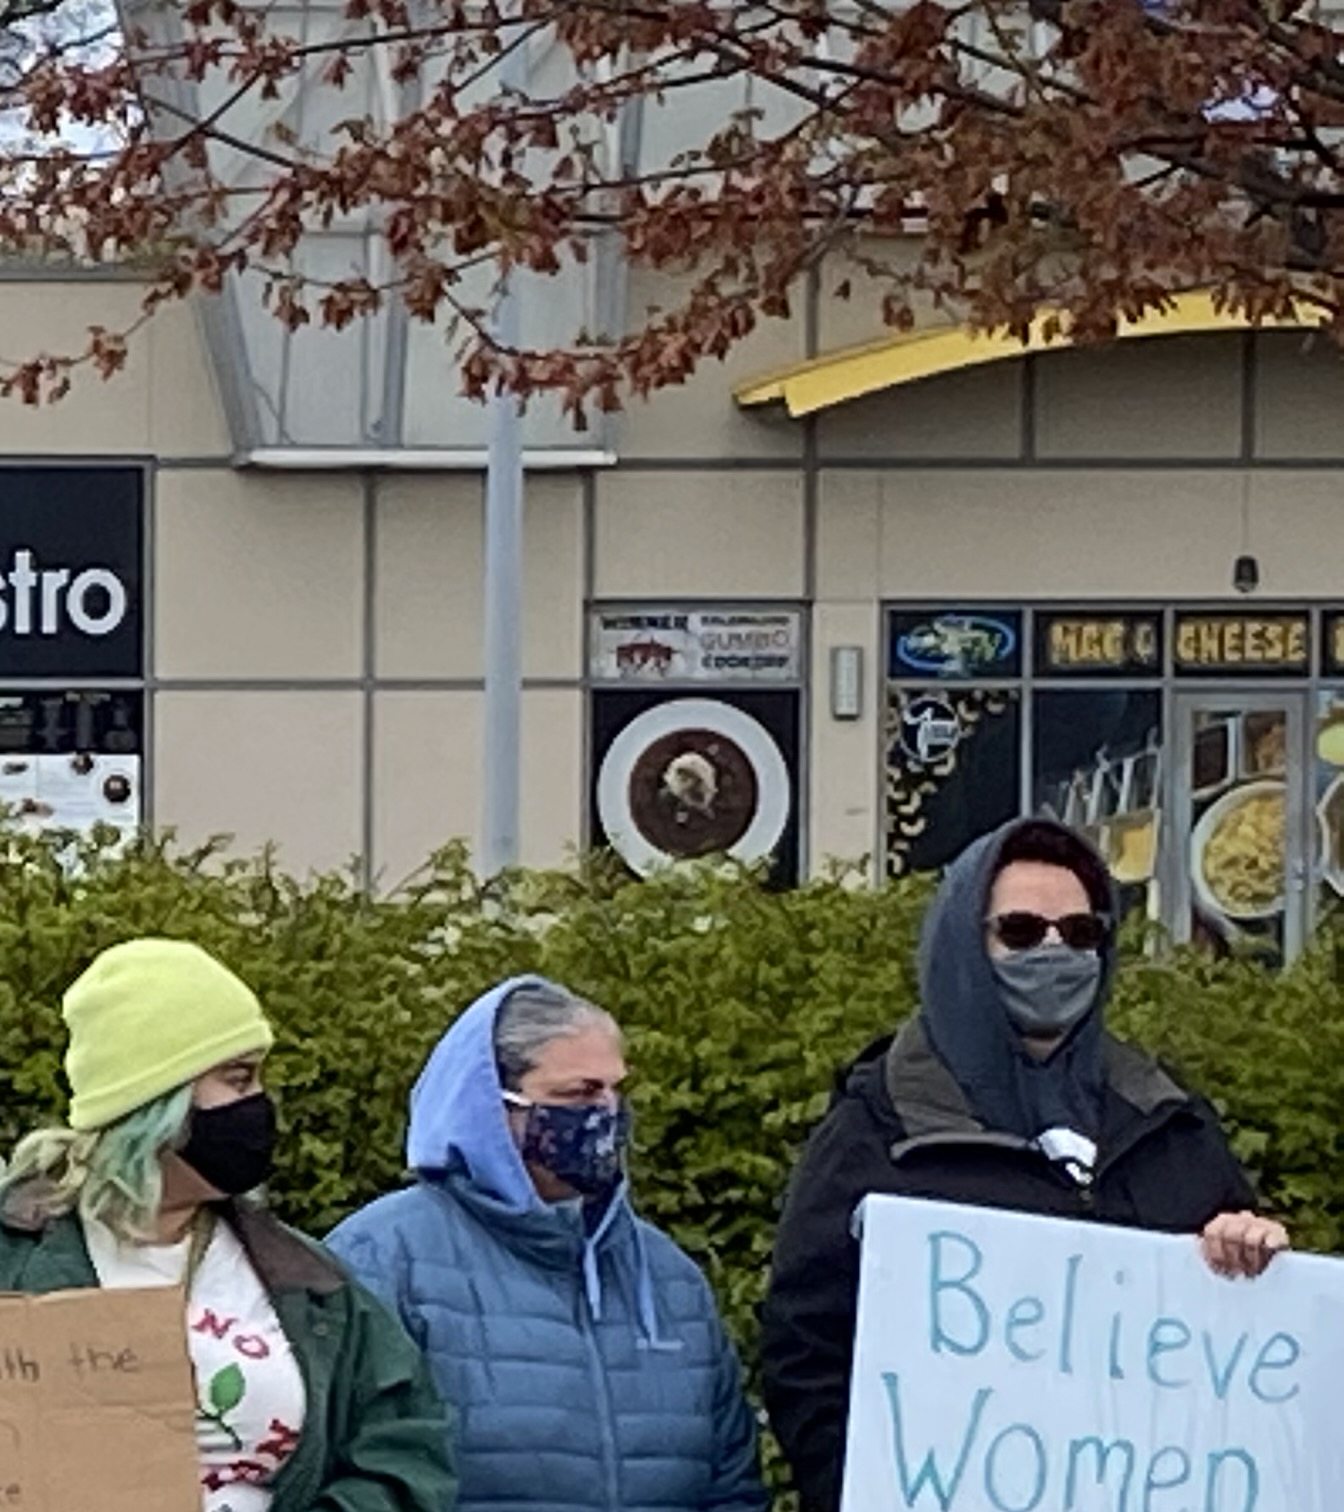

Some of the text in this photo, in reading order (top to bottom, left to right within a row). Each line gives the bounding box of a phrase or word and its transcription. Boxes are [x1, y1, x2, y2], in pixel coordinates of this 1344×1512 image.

[1176, 620, 1309, 665] CHEESE
[928, 1230, 1302, 1402] Believe
[67, 1345, 142, 1376] the
